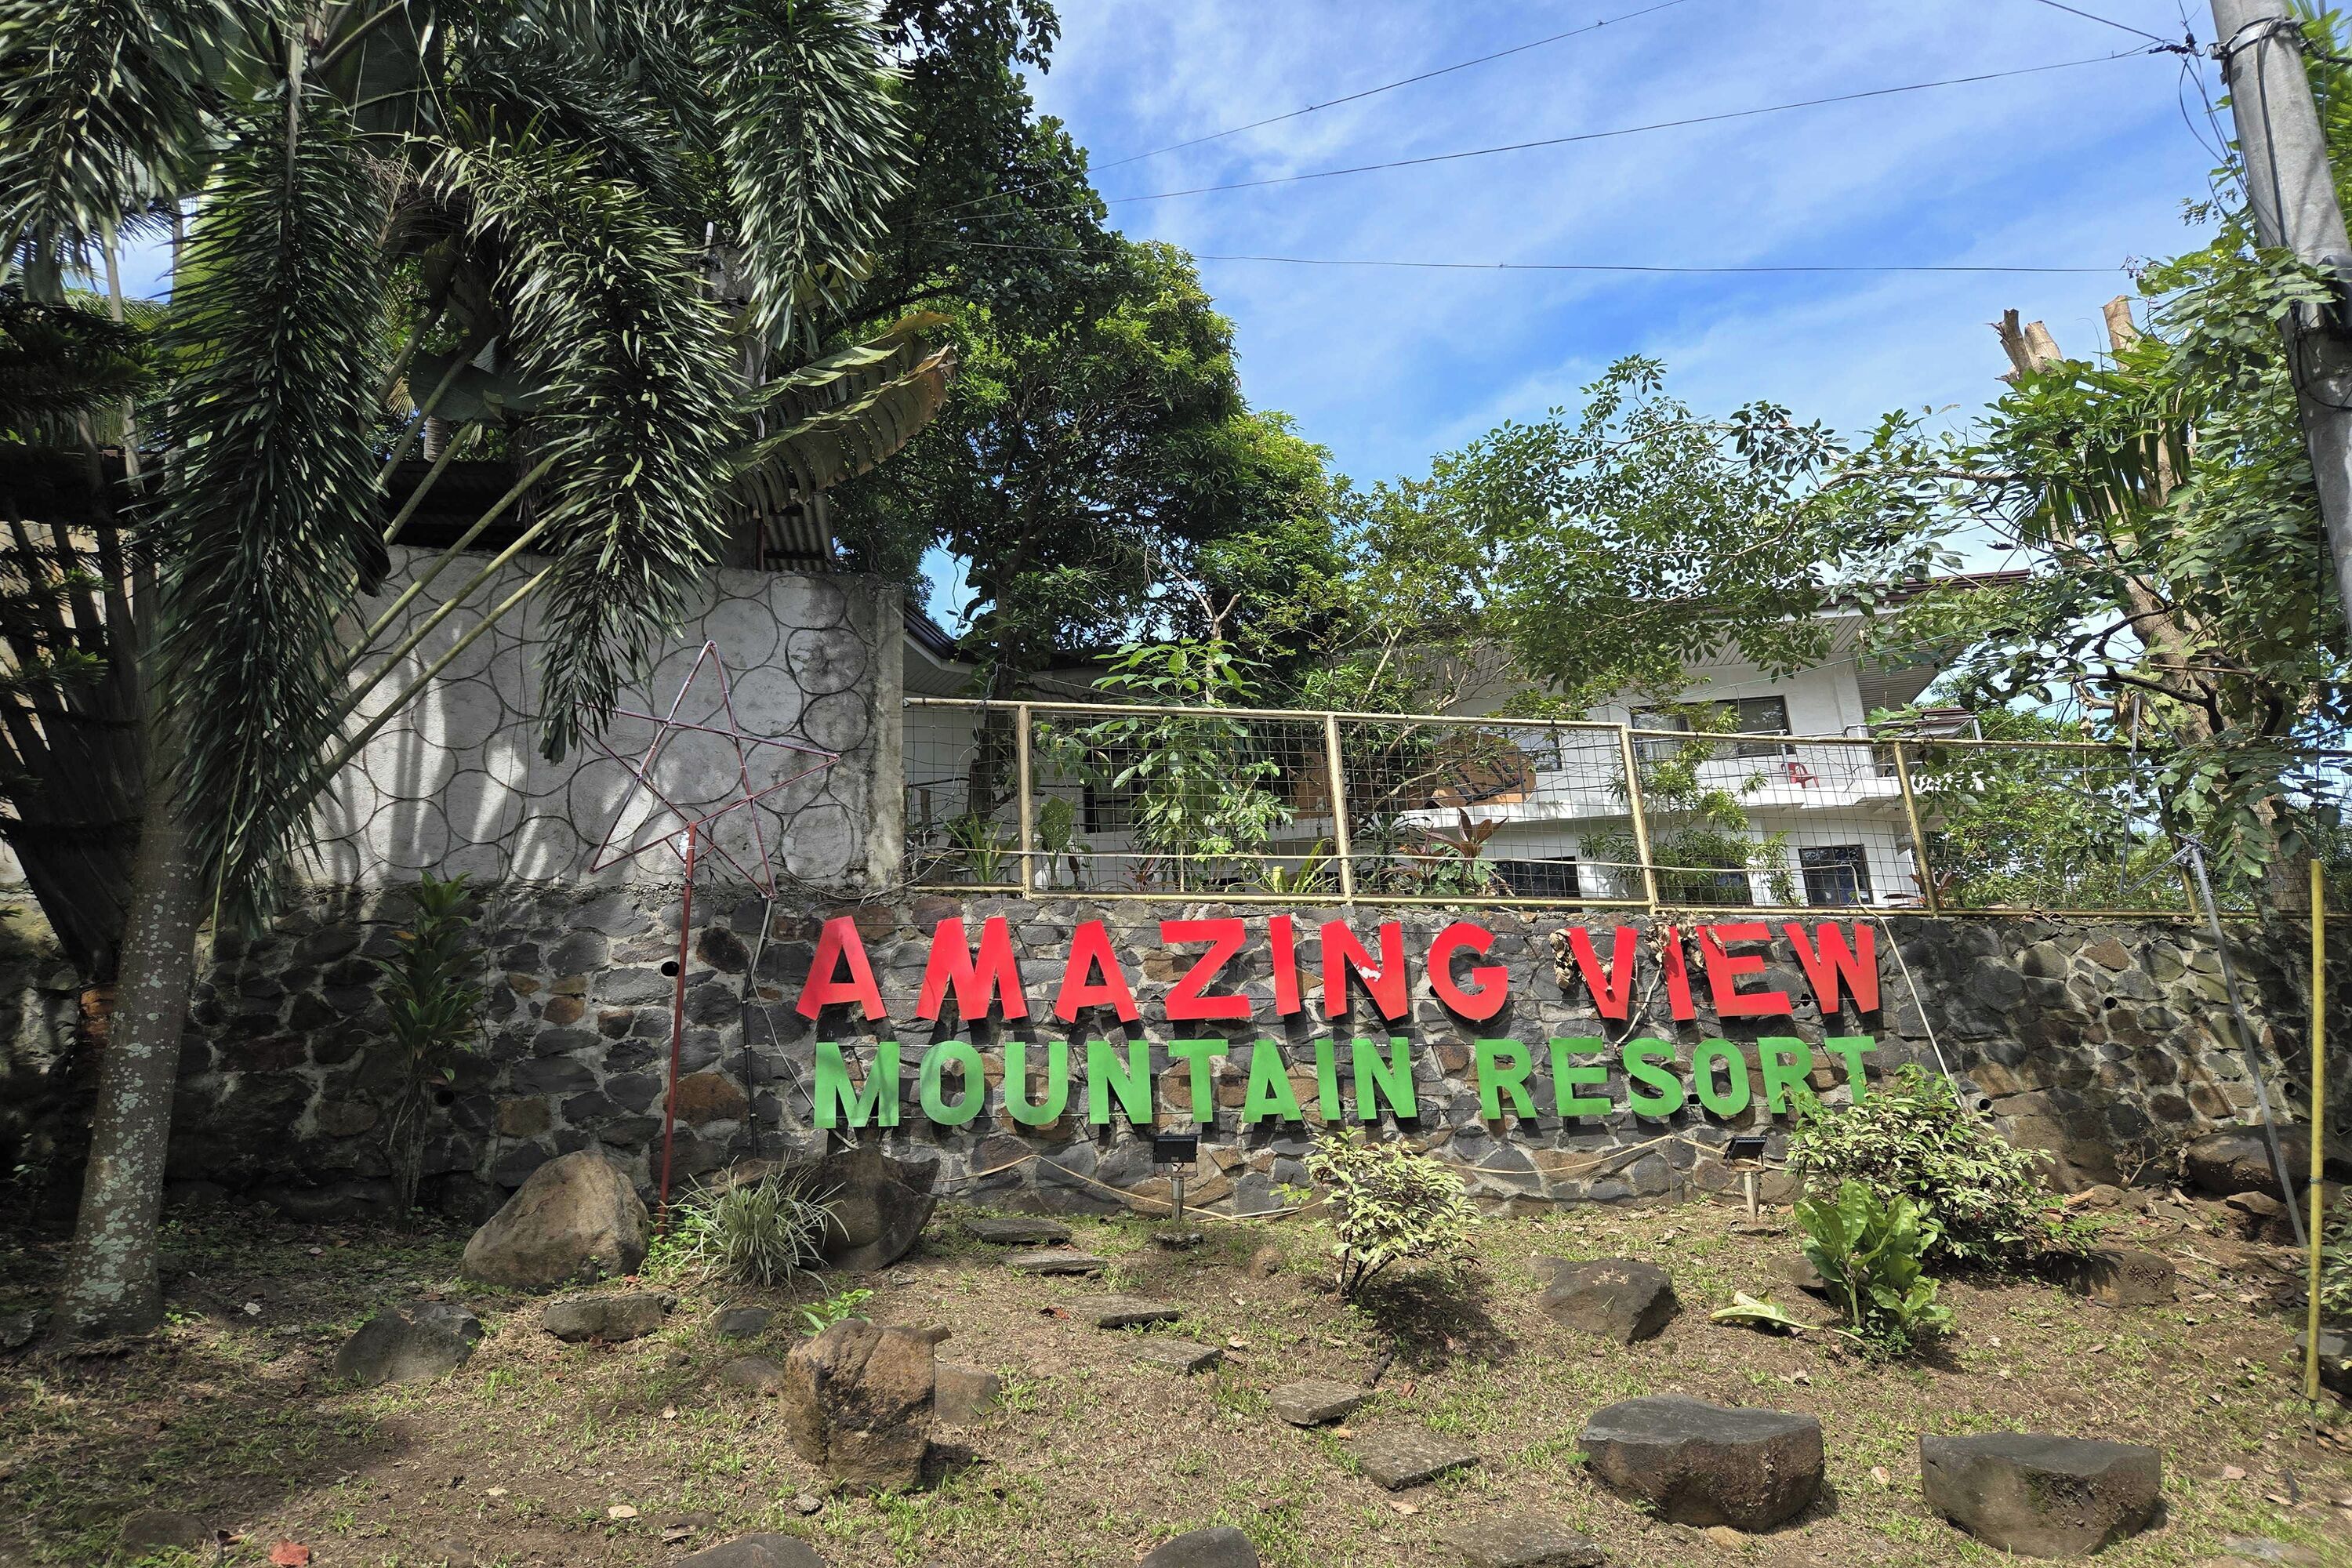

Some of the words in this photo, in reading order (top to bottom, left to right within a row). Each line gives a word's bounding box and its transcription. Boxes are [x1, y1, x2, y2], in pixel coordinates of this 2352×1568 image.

[796, 915, 1508, 1022] AMAZING
[1569, 922, 1879, 1021] VIEW
[815, 1038, 1417, 1128] MOUNTAIN
[1475, 1036, 1877, 1120] RESORT
